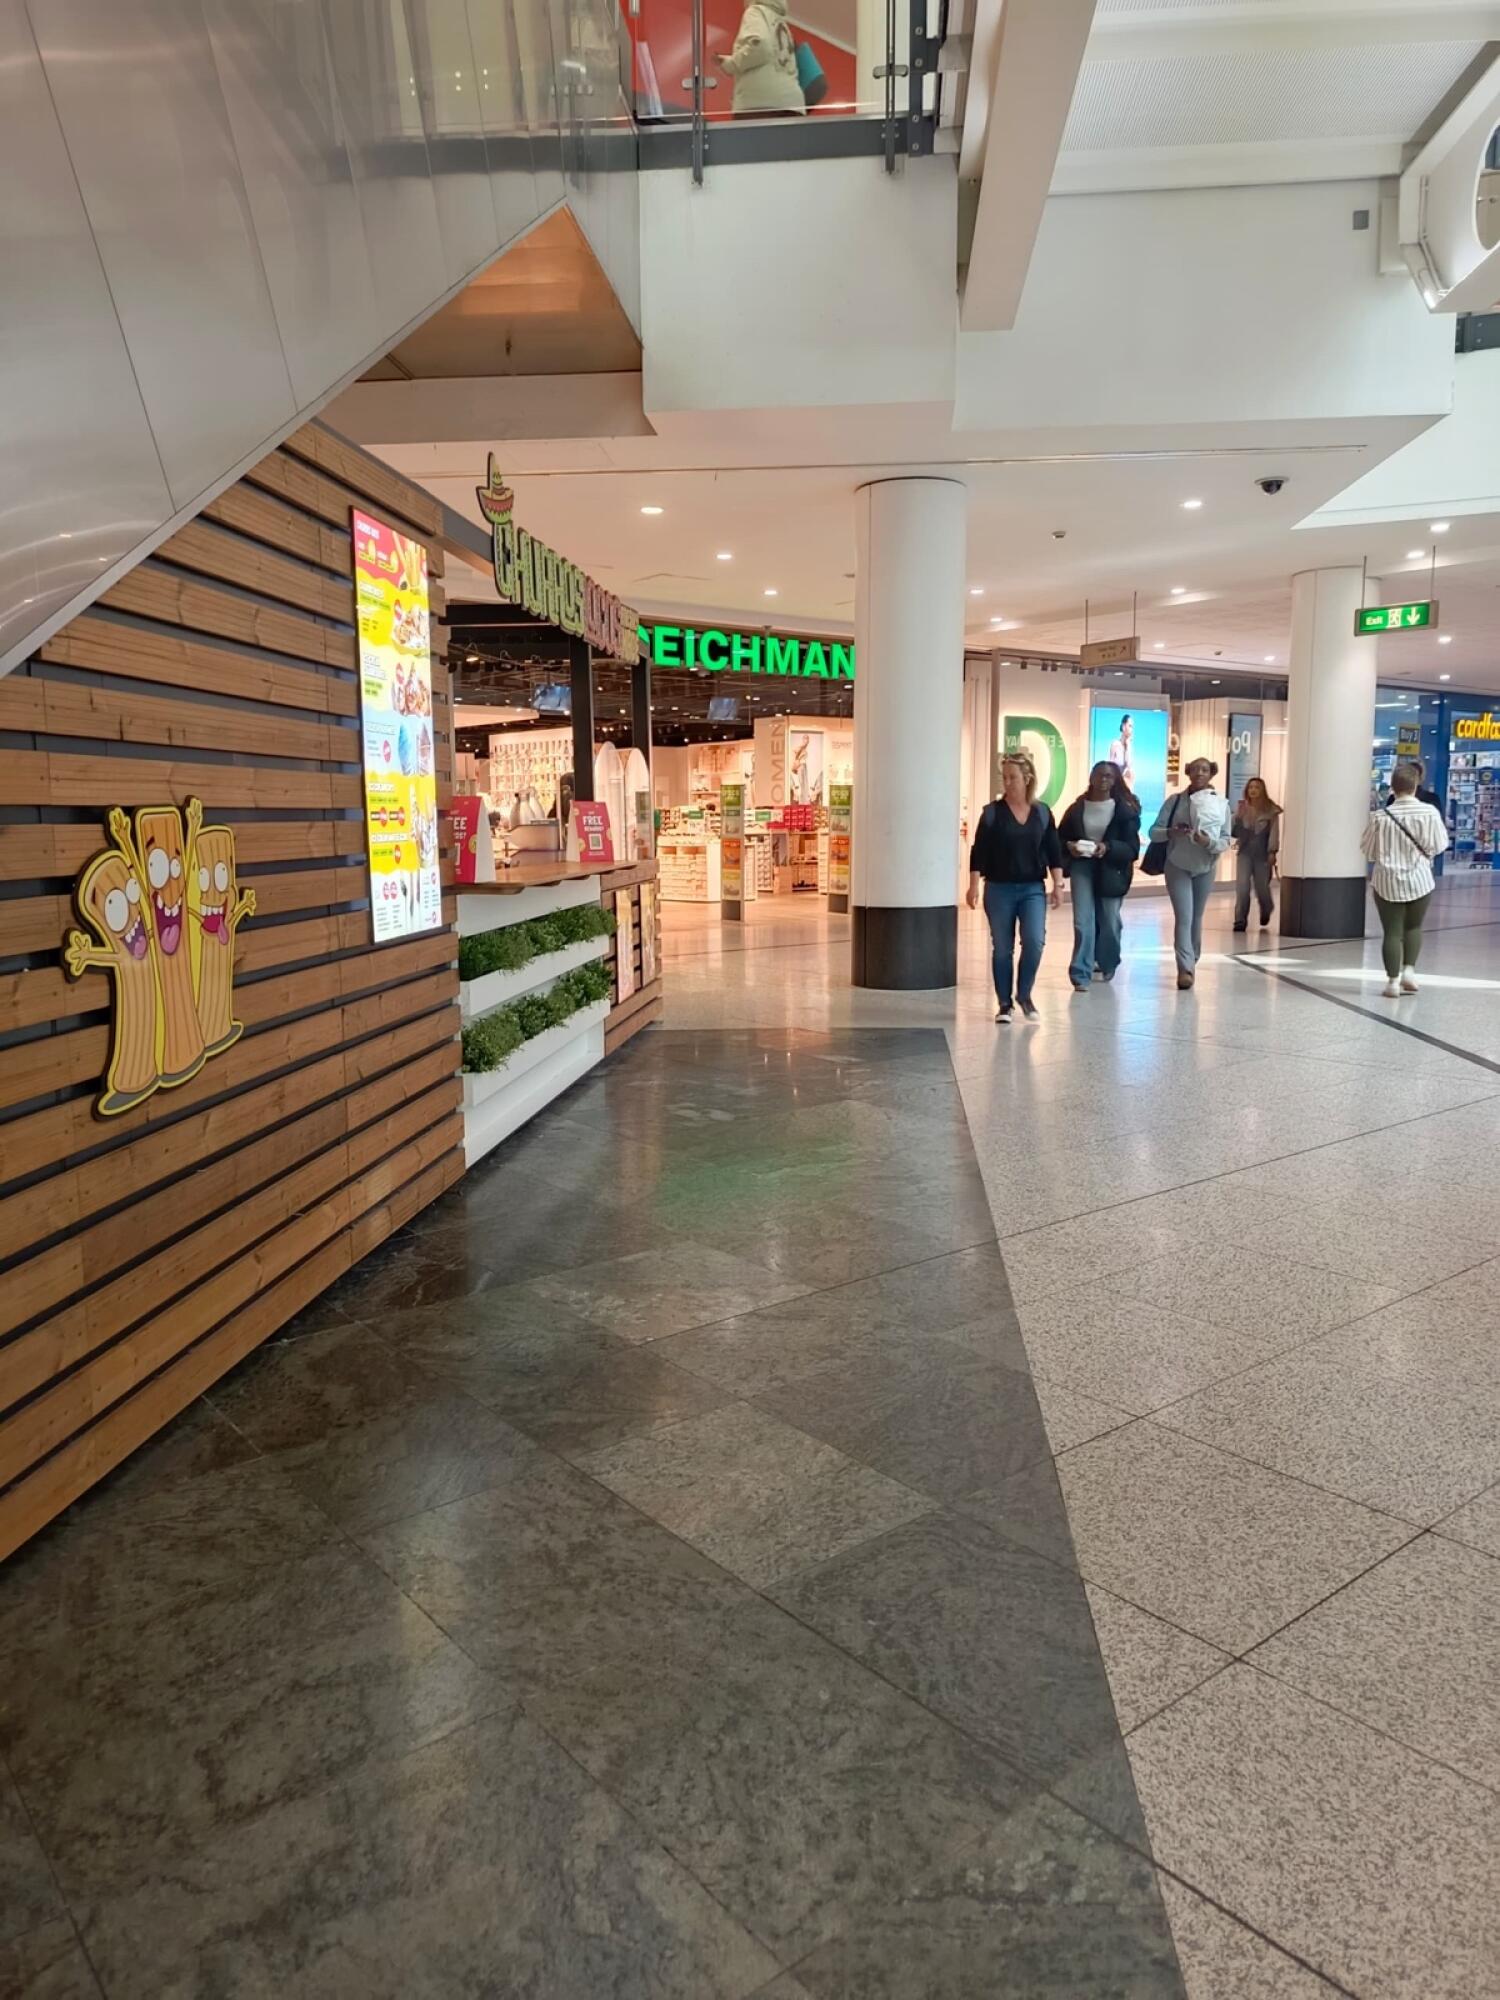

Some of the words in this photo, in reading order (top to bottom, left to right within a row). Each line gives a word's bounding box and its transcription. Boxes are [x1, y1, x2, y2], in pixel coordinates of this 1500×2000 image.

[493, 521, 586, 638] CHURROS
[1365, 615, 1383, 626] Exit
[637, 625, 855, 680] EICHMAN
[583, 815, 603, 826] FREE
